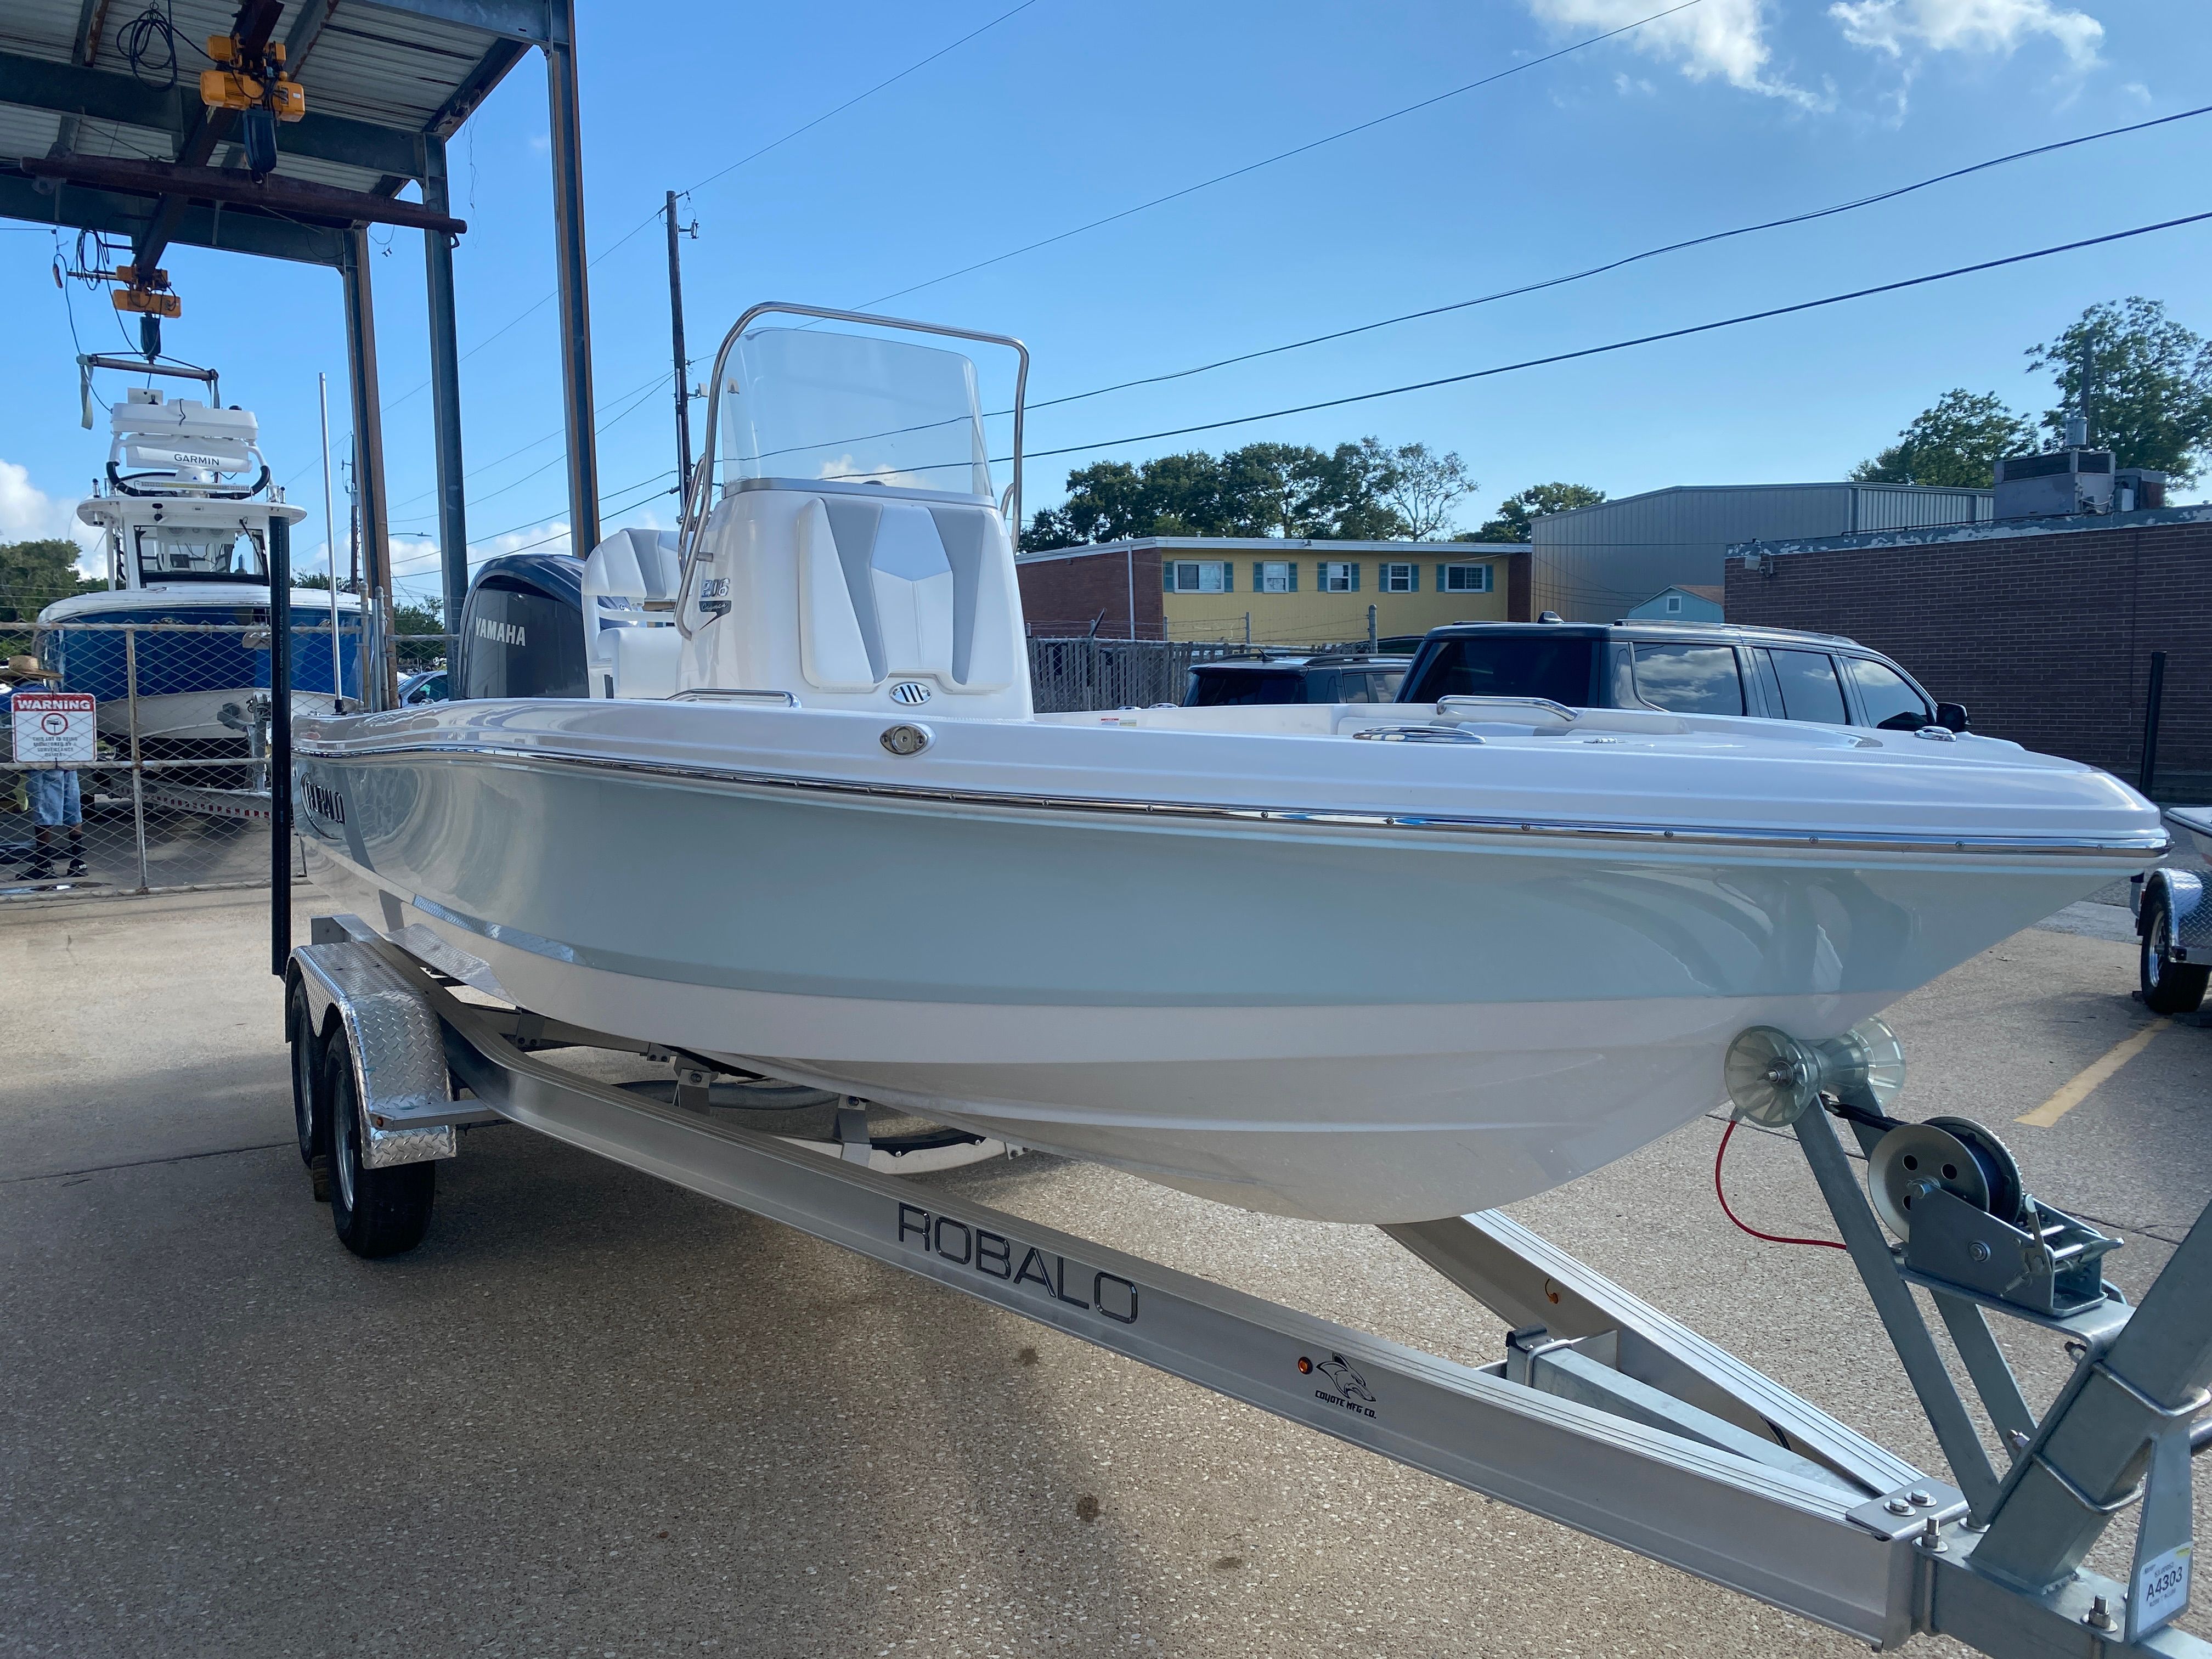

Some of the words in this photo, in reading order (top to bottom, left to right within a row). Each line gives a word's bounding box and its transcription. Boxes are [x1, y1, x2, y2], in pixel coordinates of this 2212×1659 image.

[174, 454, 219, 466] GARMIN
[701, 578, 730, 598] 206
[476, 617, 526, 646] YAMAHA
[17, 699, 91, 709] WARNING
[899, 1202, 1138, 1324] ROBALO
[1315, 1390, 1346, 1407] COYOTE
[1346, 1401, 1363, 1414] MFG
[1364, 1408, 1376, 1419] CO.
[2146, 1566, 2182, 1601] A4303
